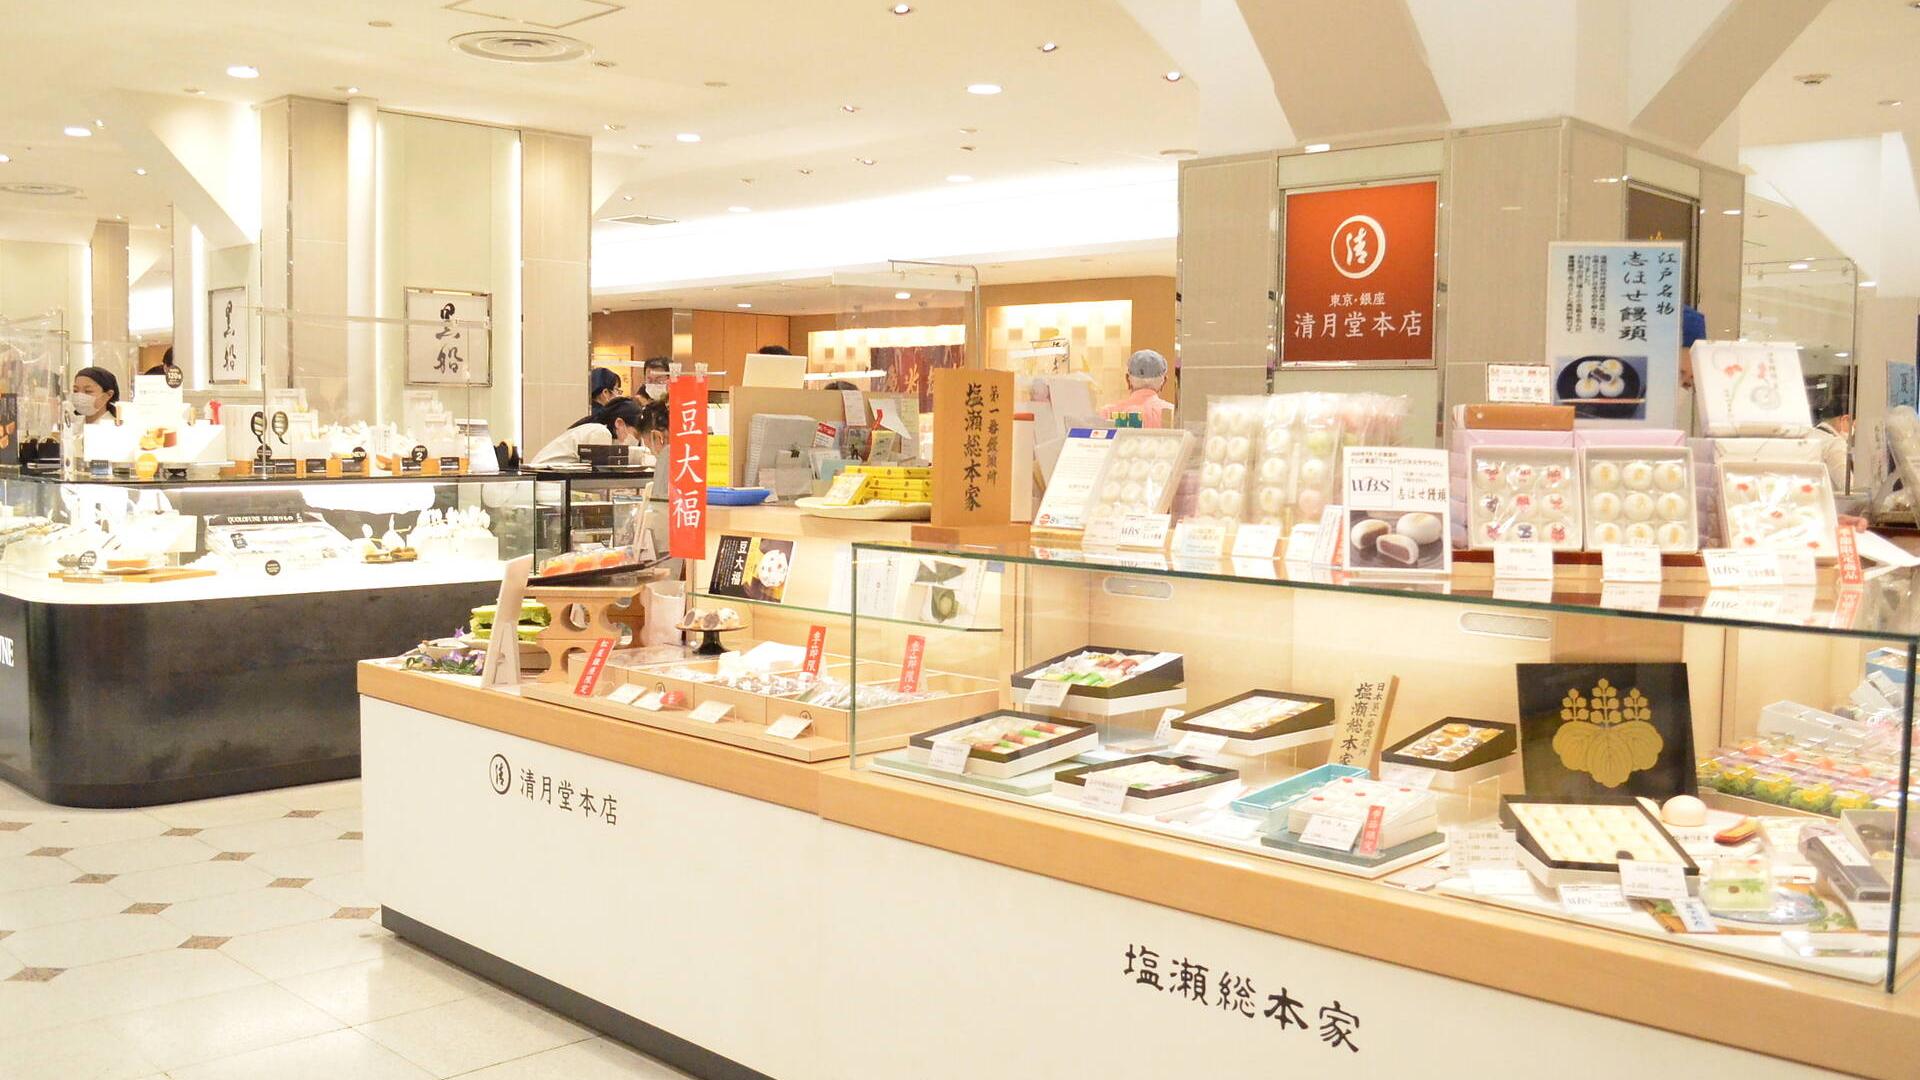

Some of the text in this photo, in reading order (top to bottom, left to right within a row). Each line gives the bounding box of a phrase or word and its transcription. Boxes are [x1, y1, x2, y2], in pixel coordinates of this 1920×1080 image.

[1656, 251, 1677, 316] 江戸名物
[1294, 310, 1423, 340] 清月堂本店
[416, 452, 424, 461] 2
[672, 400, 704, 529] 豆大福
[963, 382, 984, 512] 塩瀬総本家
[1352, 479, 1392, 493] WBS
[731, 540, 748, 586] 豆大福
[0, 635, 14, 667] NE
[806, 630, 822, 672] 季節限
[520, 767, 618, 826] 清月堂本店
[1124, 944, 1360, 1053] 塩瀬総本家
